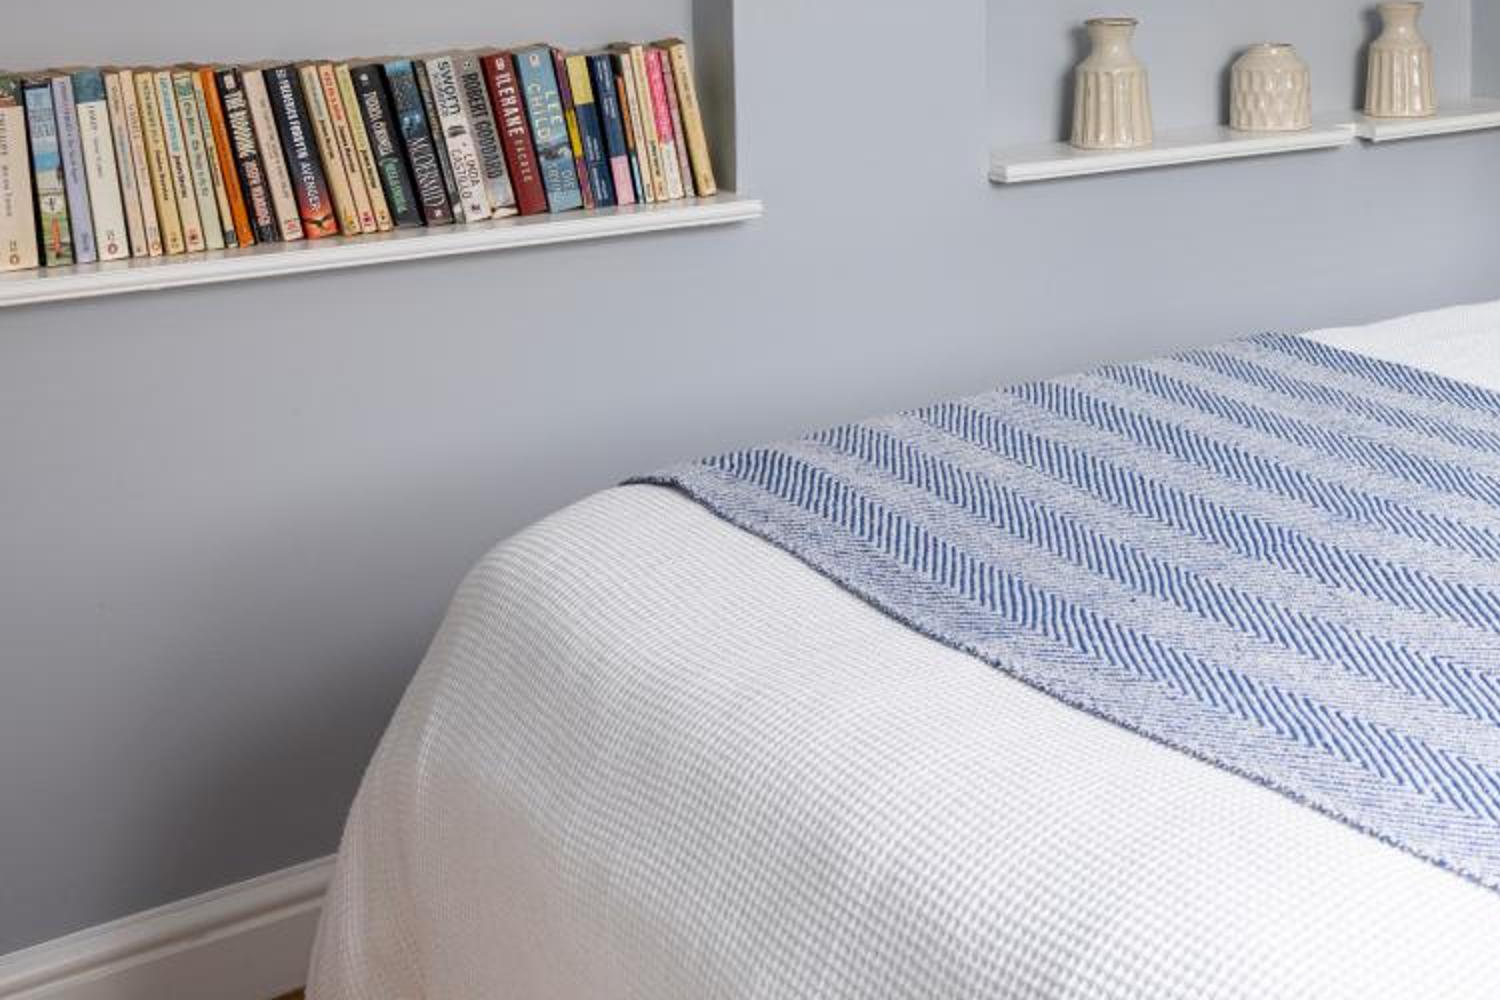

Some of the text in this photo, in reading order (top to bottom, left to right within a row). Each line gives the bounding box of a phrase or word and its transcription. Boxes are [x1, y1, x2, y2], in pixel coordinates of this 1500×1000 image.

[462, 72, 502, 179] ROBERT GODDARD
[528, 83, 551, 140] CHILD
[545, 90, 562, 125] LEE
[301, 162, 319, 210] AVENGER
